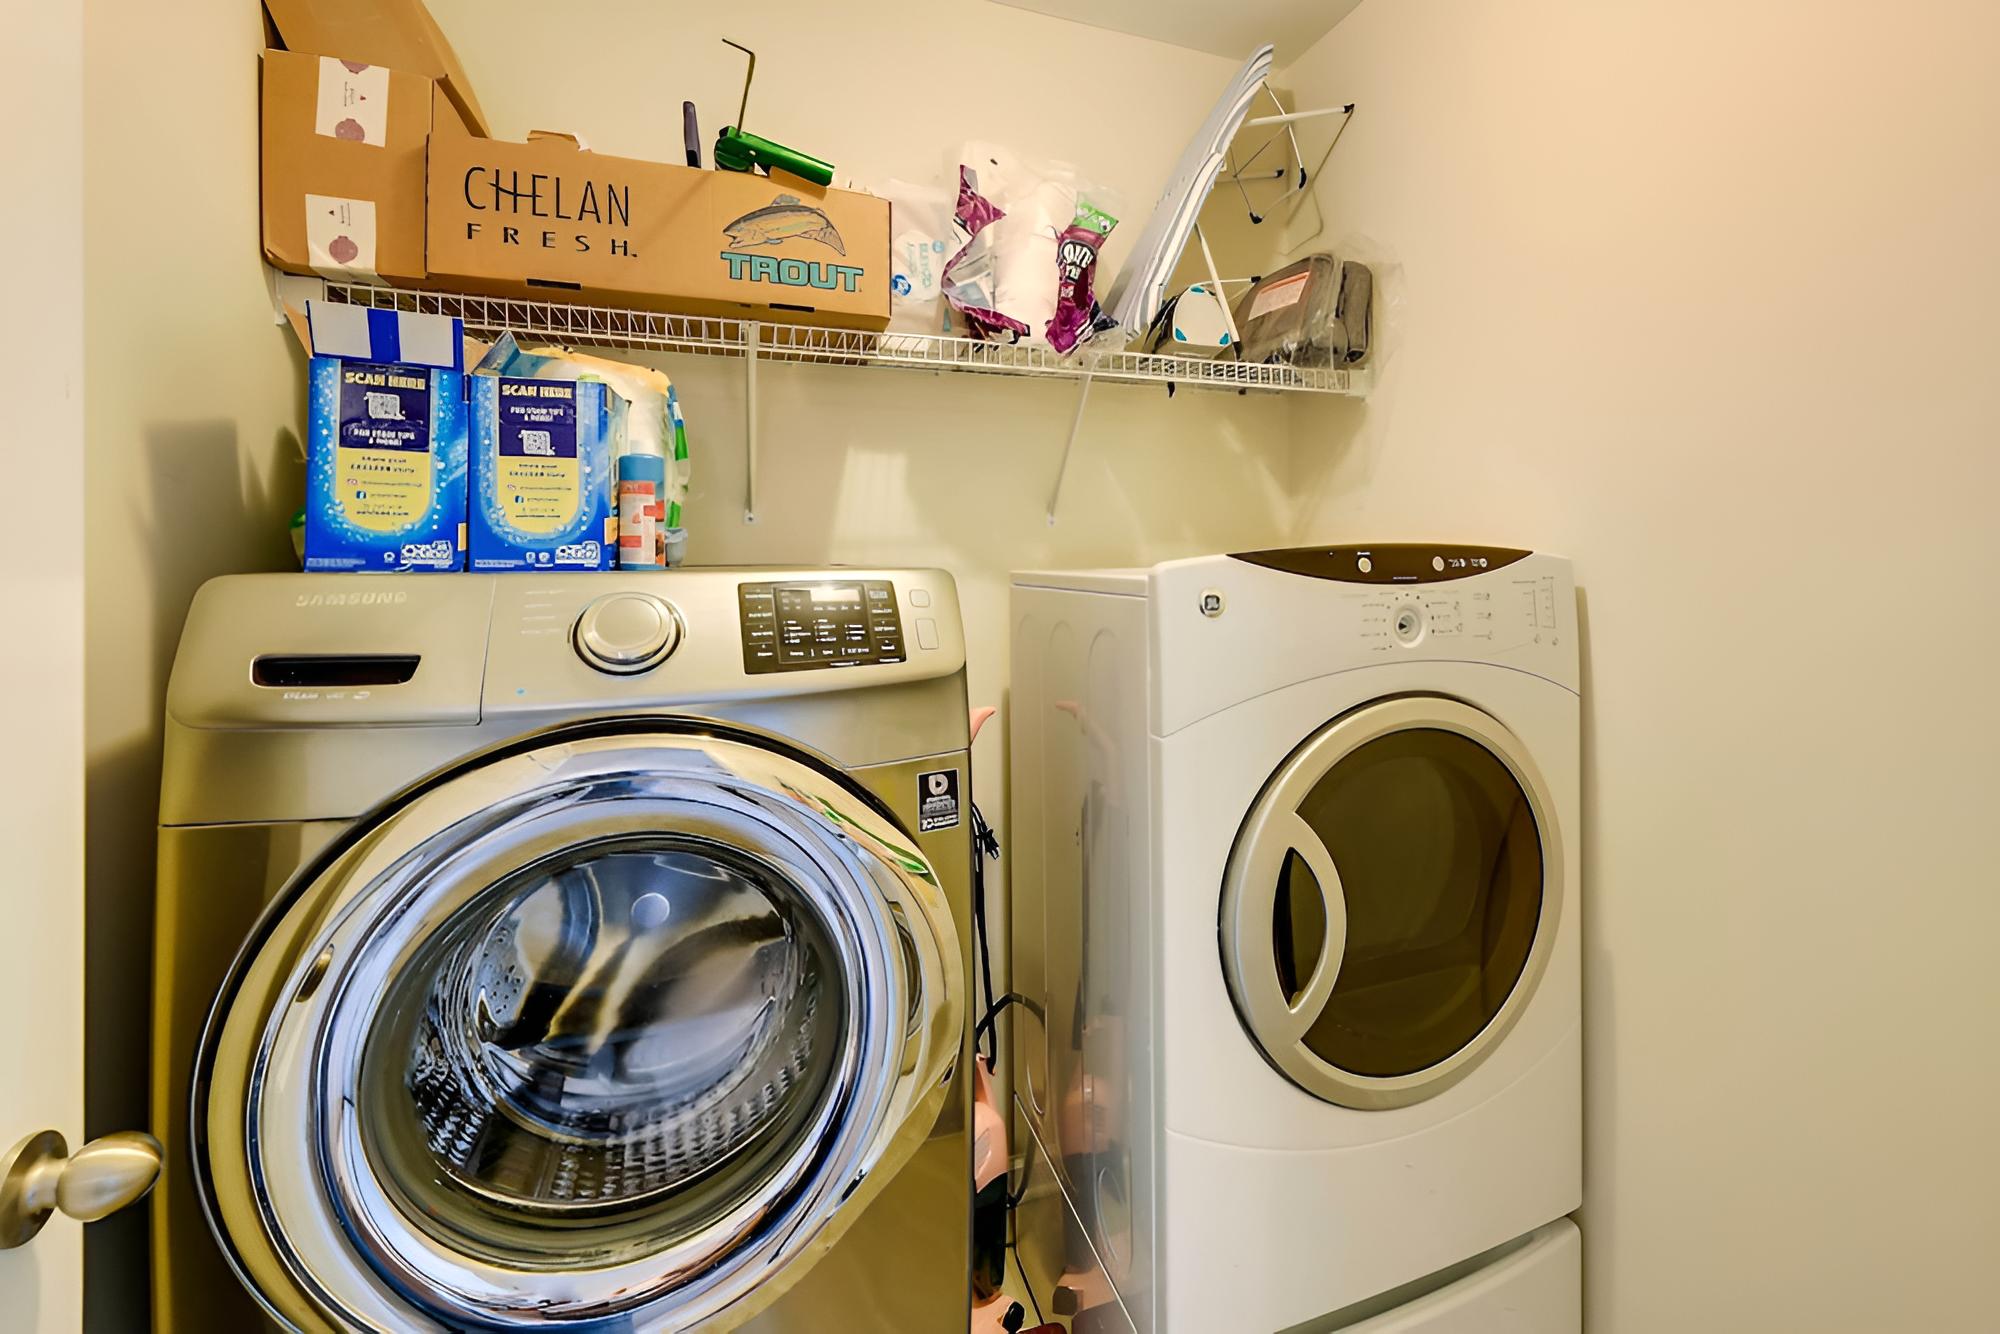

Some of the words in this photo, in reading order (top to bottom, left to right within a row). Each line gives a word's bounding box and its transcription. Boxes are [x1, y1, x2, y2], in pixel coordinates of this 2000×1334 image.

[464, 166, 629, 227] CHELAN
[720, 250, 864, 293] TROUT
[295, 590, 408, 608] SAMSUNG
